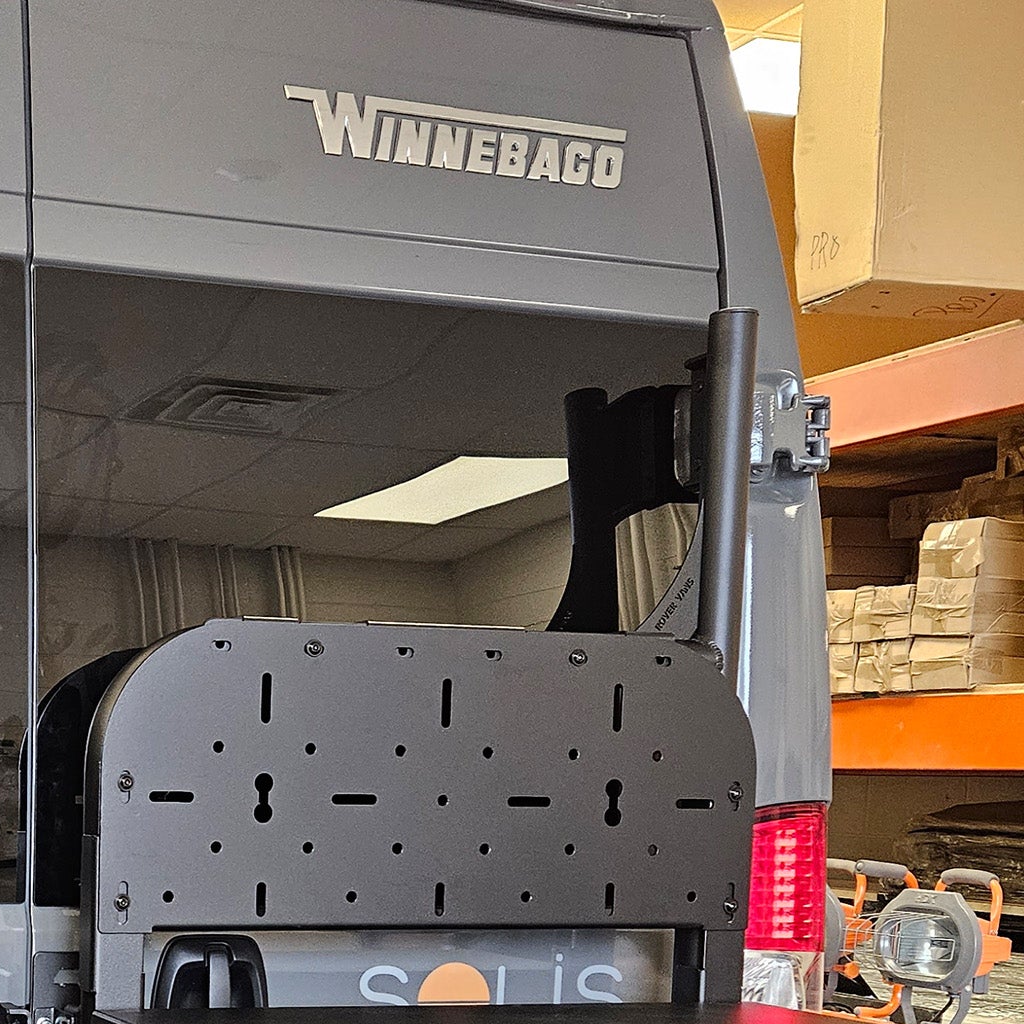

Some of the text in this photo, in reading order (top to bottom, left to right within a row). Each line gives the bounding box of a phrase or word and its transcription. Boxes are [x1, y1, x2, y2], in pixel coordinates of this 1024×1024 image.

[283, 84, 627, 189] WINNEBAGO
[654, 577, 695, 632] ROVER VANS
